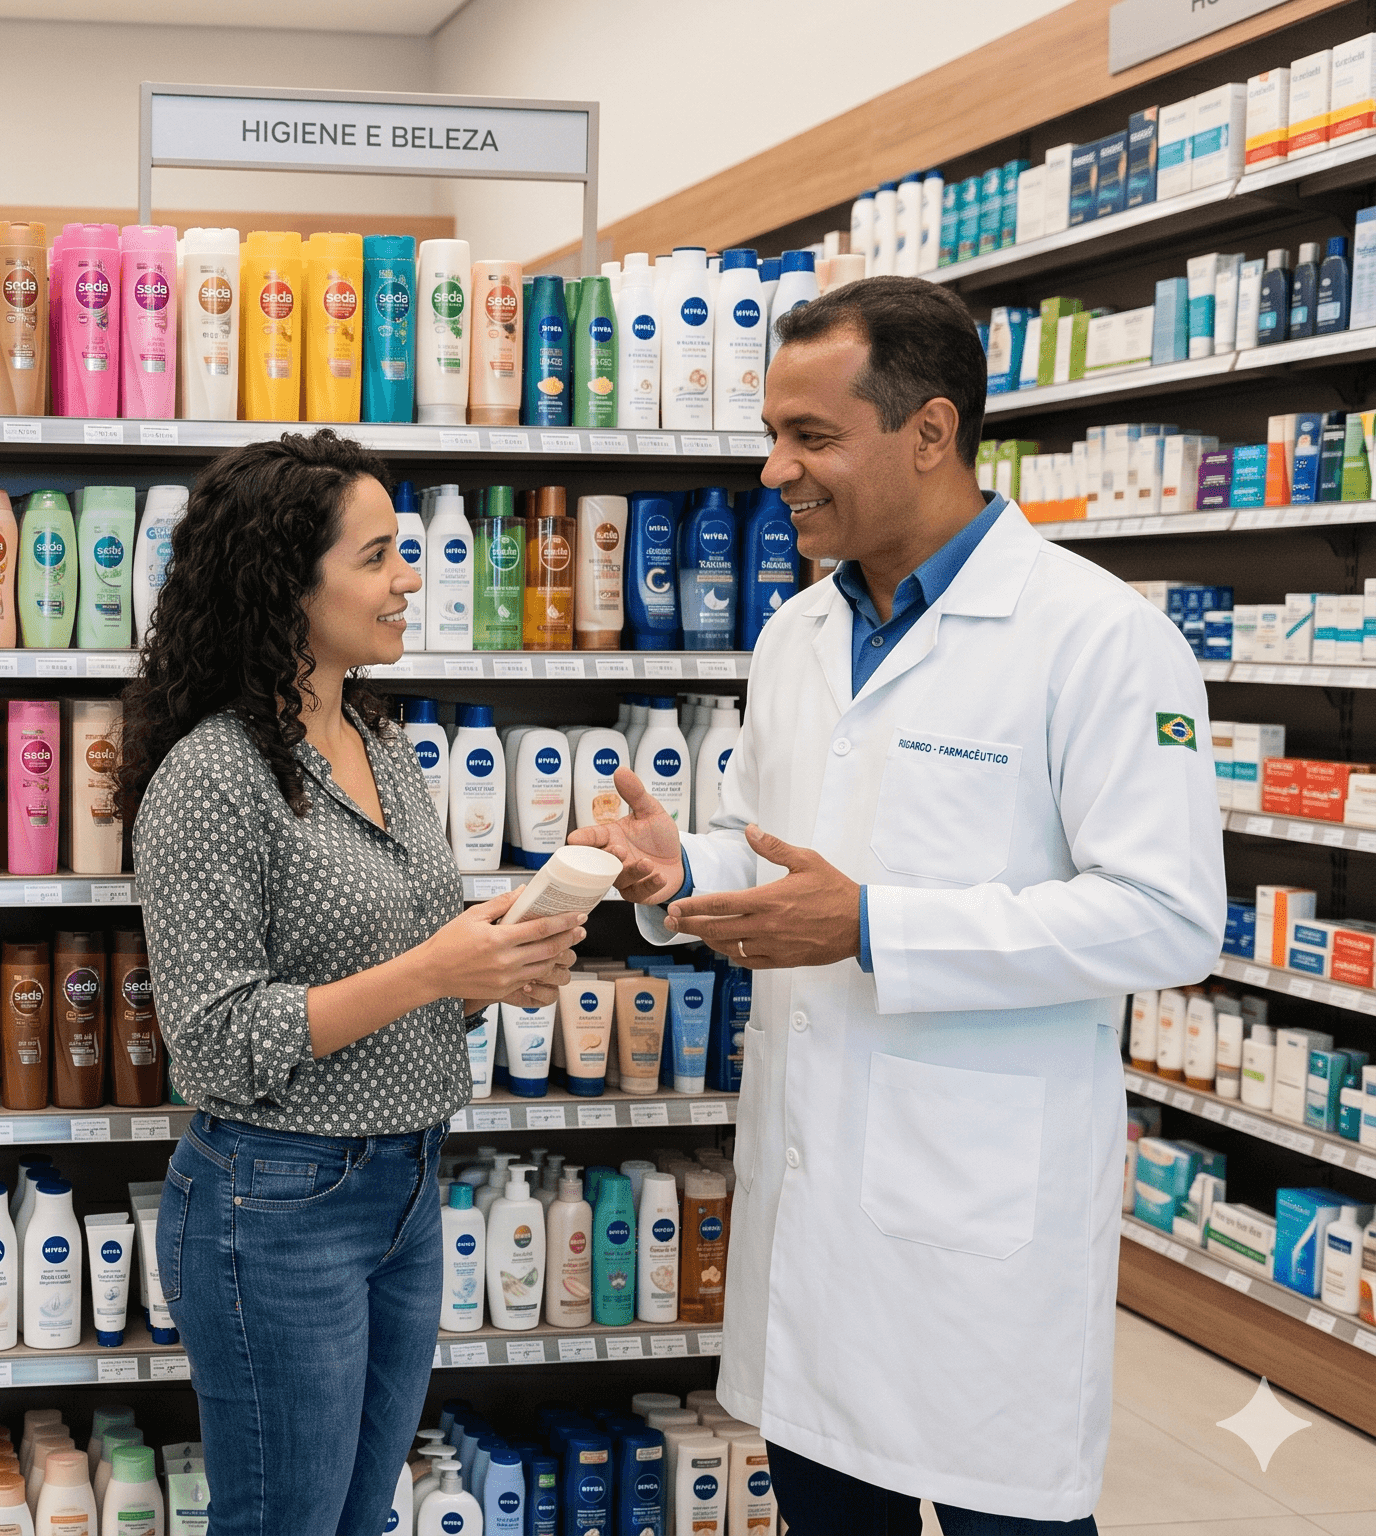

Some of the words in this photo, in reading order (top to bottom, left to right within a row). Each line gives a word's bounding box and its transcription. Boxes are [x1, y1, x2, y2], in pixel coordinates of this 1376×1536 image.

[242, 119, 357, 146] HIGIENE
[366, 124, 382, 147] E
[391, 126, 500, 152] BELEZA
[378, 291, 409, 303] seda
